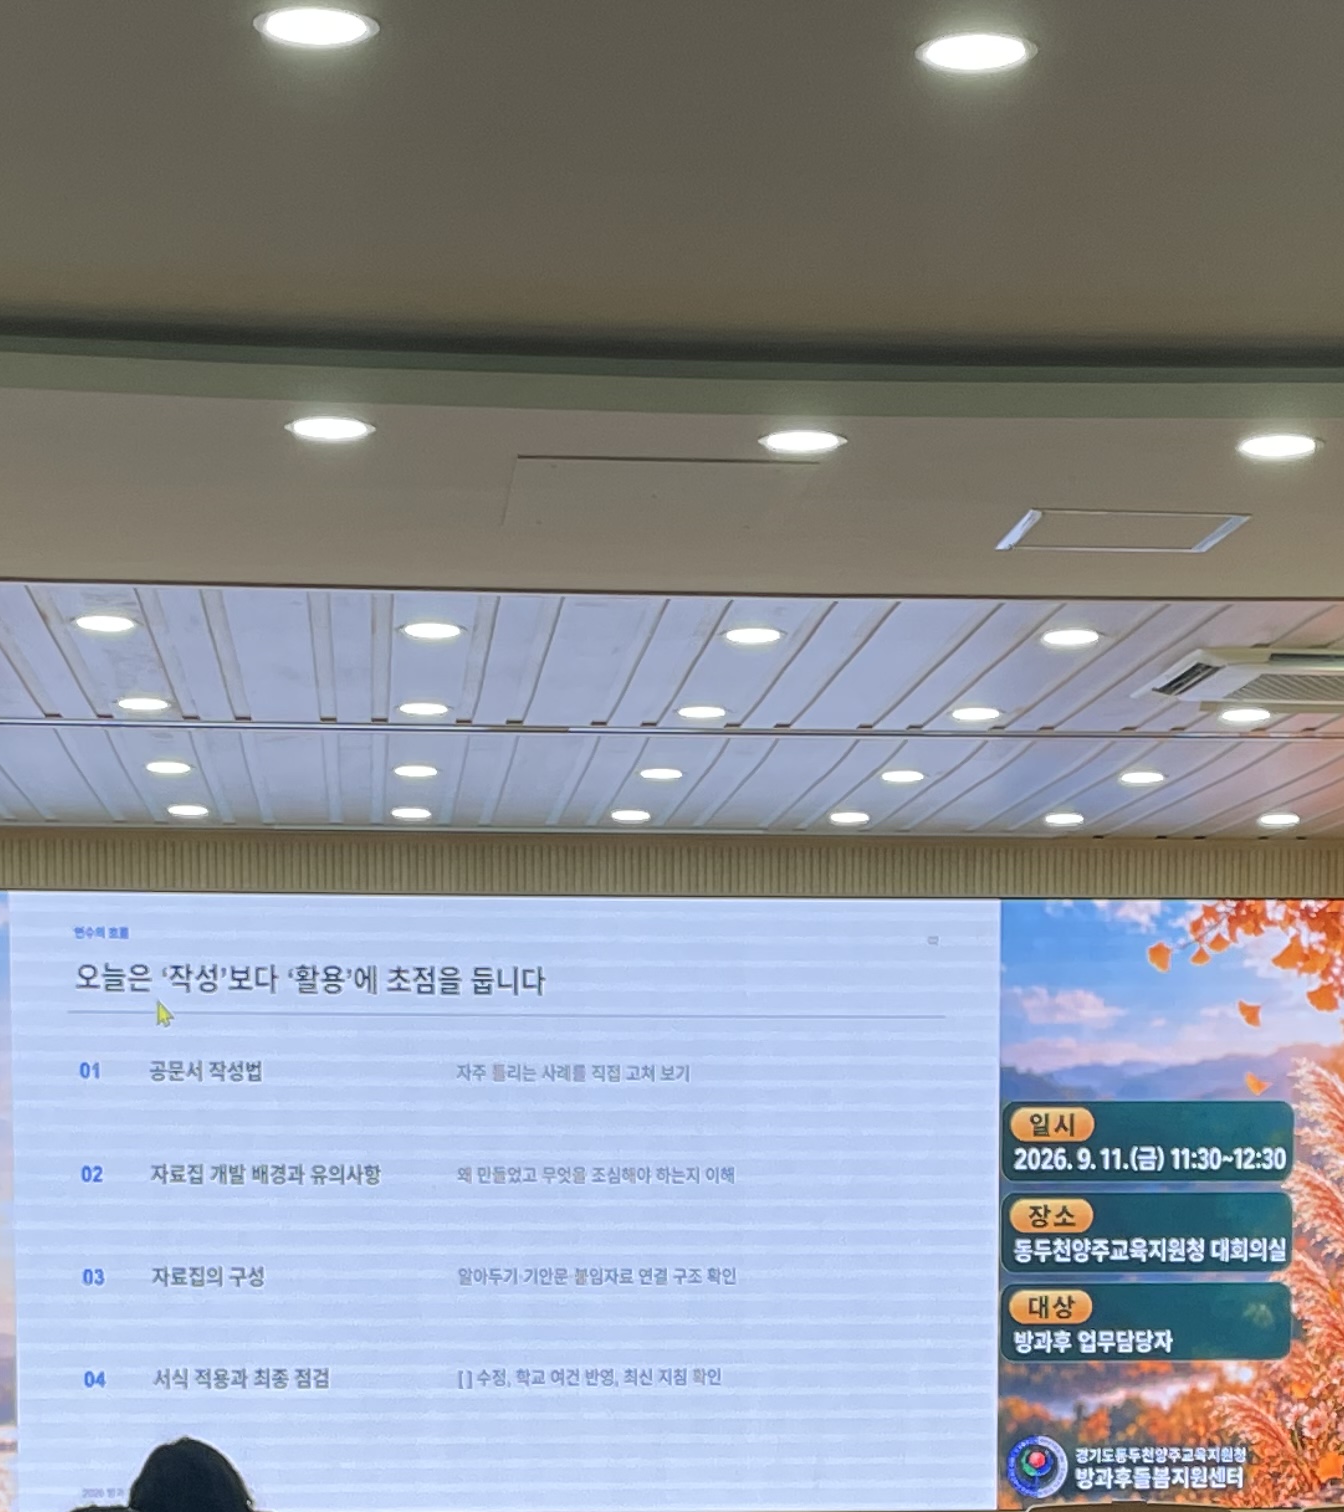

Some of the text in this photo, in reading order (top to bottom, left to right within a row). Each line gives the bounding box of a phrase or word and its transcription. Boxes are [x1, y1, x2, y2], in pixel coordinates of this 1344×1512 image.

[76, 963, 154, 993] 오늘은
[386, 966, 463, 995] 초점을
[470, 967, 546, 996] 둡니다
[79, 1061, 263, 1083] 01 공문서 작성법
[456, 1064, 487, 1082] 자주
[591, 1064, 621, 1083] 직접
[625, 1064, 656, 1083] 고쳐
[660, 1065, 691, 1083] 보기
[1013, 1147, 1073, 1171] 2026.
[1077, 1147, 1097, 1171] 9.
[1171, 1147, 1287, 1171] 11:30~12:30
[81, 1164, 382, 1185] 02 자료집 개발 배경과 유의사항
[542, 1167, 586, 1184] 무엇을
[591, 1167, 651, 1184] 조심해야
[656, 1167, 701, 1184] 하는지
[705, 1167, 736, 1184] 이해
[1013, 1237, 1287, 1263] 동두천양주교육지원청 대회의실
[82, 1266, 265, 1287] 03 자료집의 구성
[638, 1268, 668, 1286] 연결
[672, 1268, 703, 1286] 구조
[707, 1267, 736, 1286] 확인
[1014, 1330, 1174, 1354] 방과후 업무담당자
[84, 1368, 330, 1389] 04 서식 적용과 최종 점검
[516, 1368, 546, 1387] 학교
[550, 1368, 580, 1387] 여건
[623, 1368, 654, 1387] 최신
[657, 1368, 687, 1387] 지침
[692, 1368, 722, 1386] 확인
[1075, 1466, 1245, 1490] 방과후돌봄지원센터
